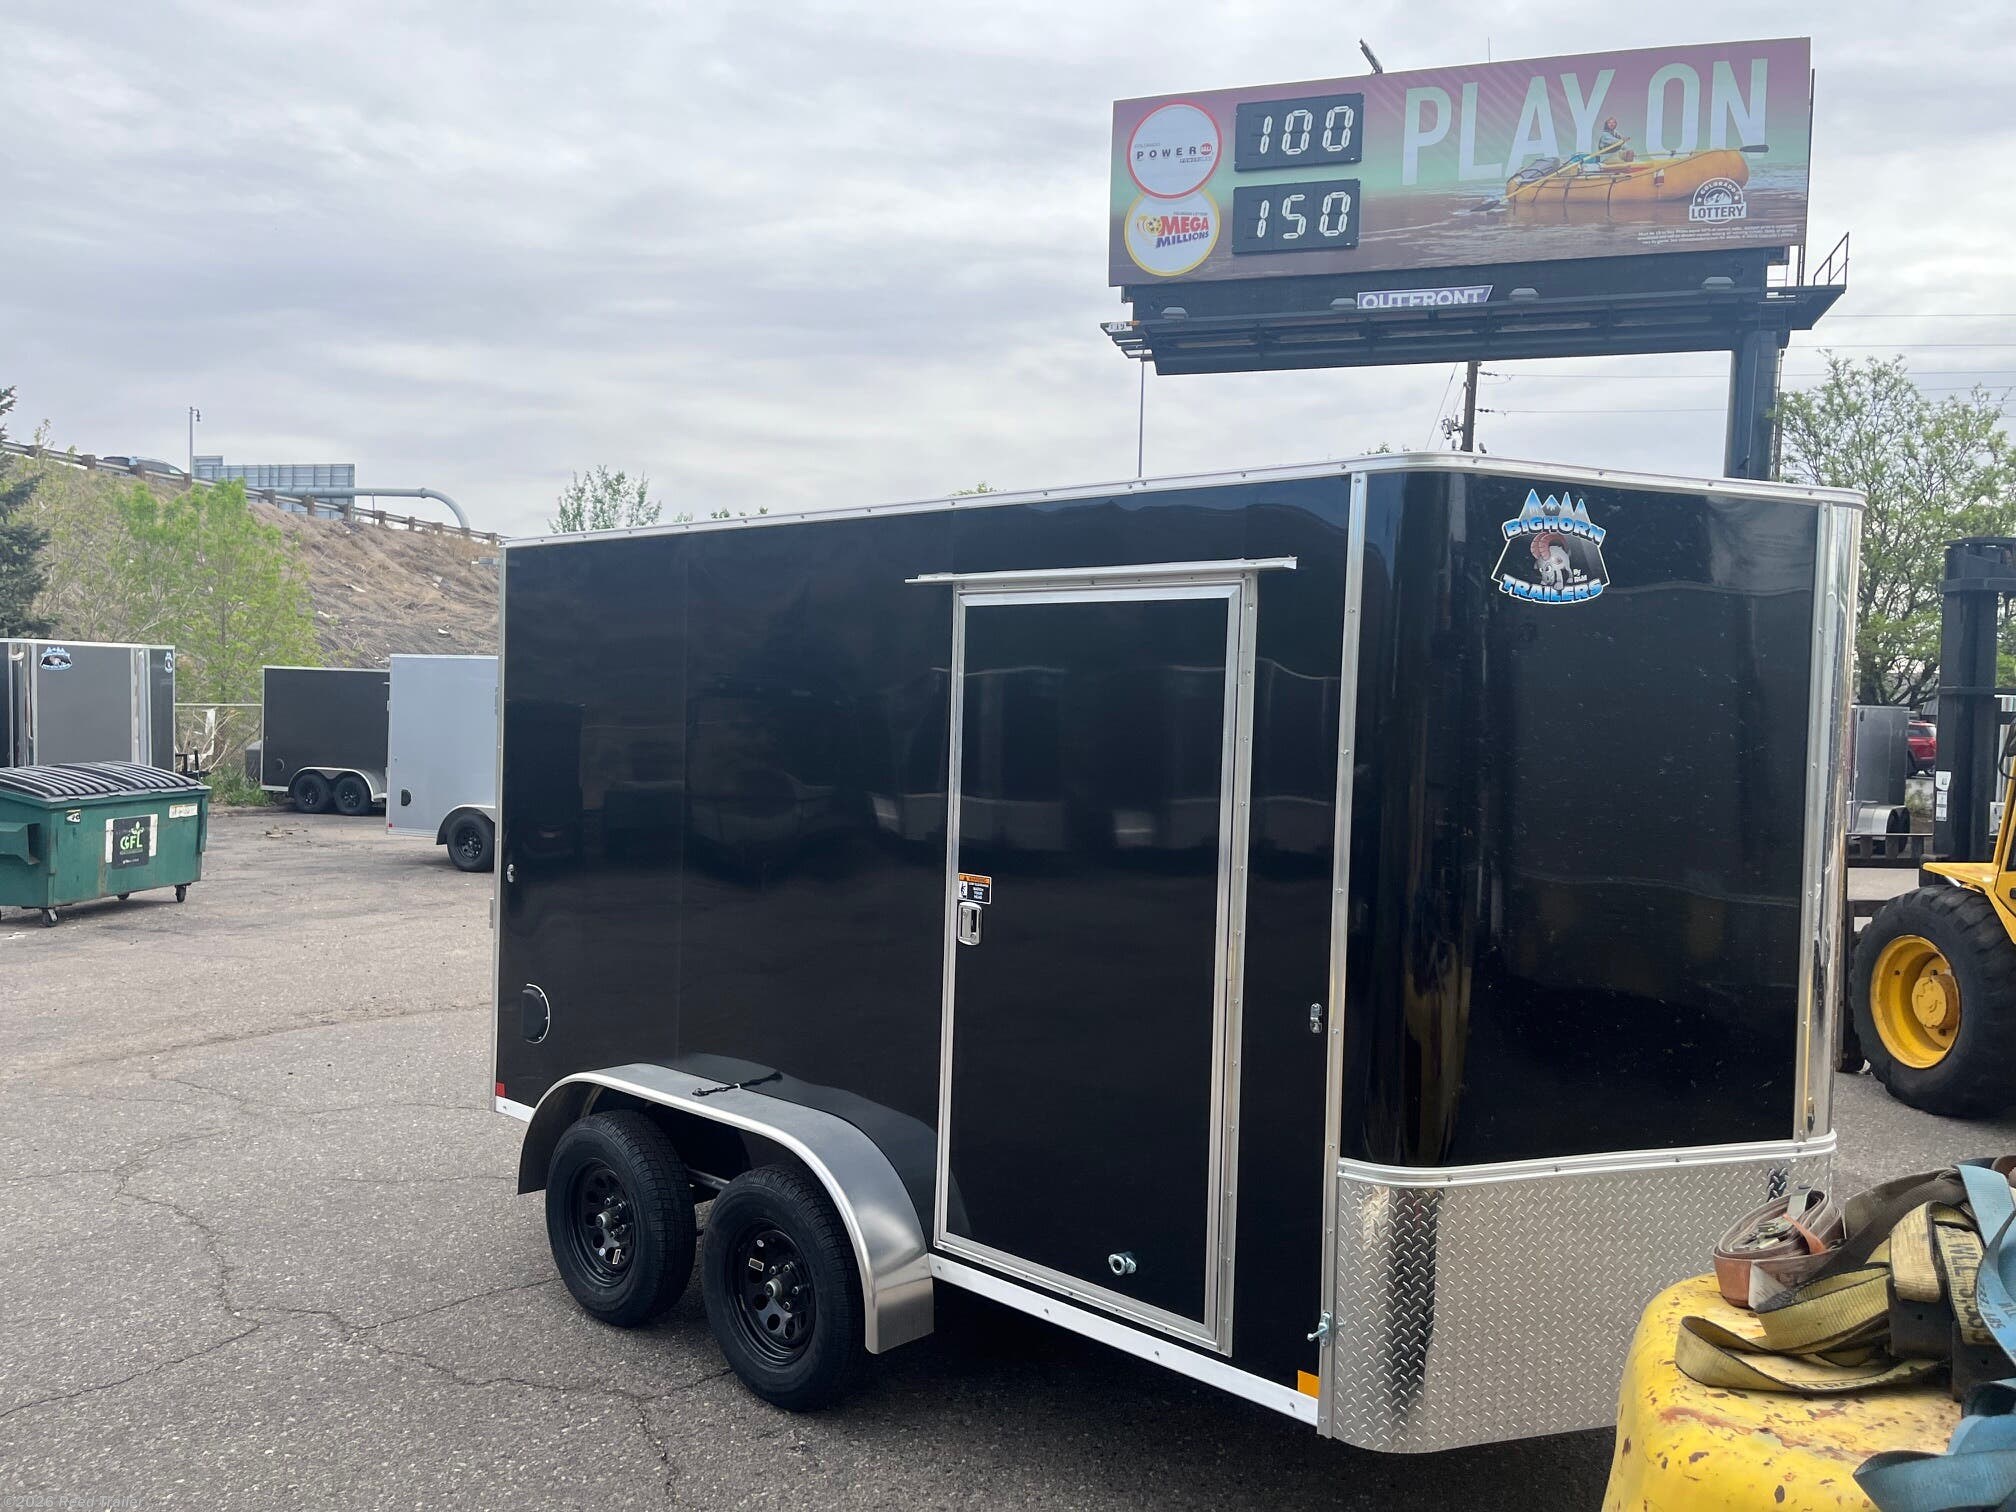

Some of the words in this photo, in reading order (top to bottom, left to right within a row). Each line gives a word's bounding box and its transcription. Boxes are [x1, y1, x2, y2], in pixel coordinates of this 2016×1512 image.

[1259, 105, 1354, 154] 100
[1402, 69, 1616, 186] PLAY
[1646, 58, 1768, 158] ON
[1137, 146, 1197, 160] POWER
[1256, 191, 1351, 239] 150
[1691, 205, 1744, 219] LOTTERY
[1157, 215, 1209, 237] MEGA
[1156, 231, 1209, 248] MILLIONS
[1362, 289, 1484, 308] OUTFRONT
[1503, 516, 1606, 546] BIGHORN
[1502, 574, 1604, 602] TRAILERS
[120, 831, 143, 850] GFL
